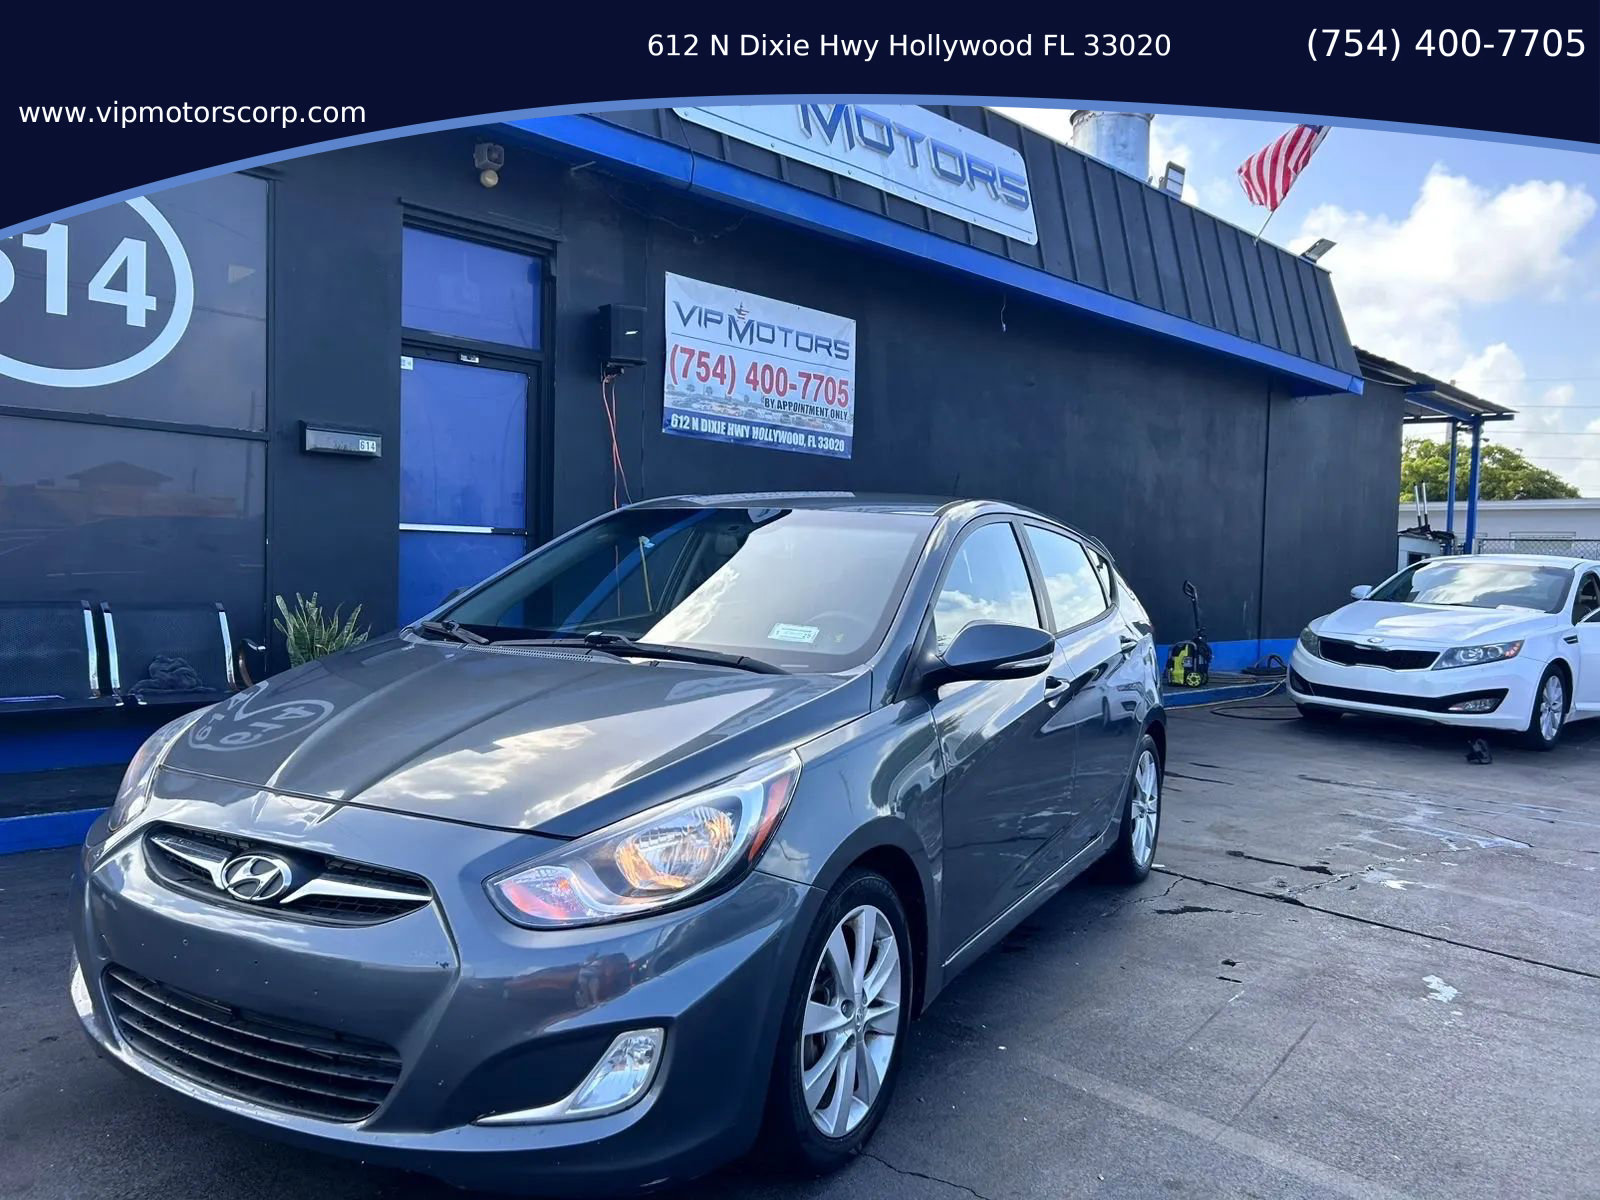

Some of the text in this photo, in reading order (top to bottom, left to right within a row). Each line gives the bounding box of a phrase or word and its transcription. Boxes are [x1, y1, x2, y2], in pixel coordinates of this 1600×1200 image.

[800, 104, 1029, 211] MOTORS
[673, 301, 849, 361] VIP MOTORS
[670, 343, 849, 408] (754) 400-7705
[671, 413, 845, 452] 612 N DIXIE HWY HOLLYWOOD, FL 33020
[764, 398, 848, 420] BY APPOINTMENT ONLY
[360, 440, 375, 451] 614
